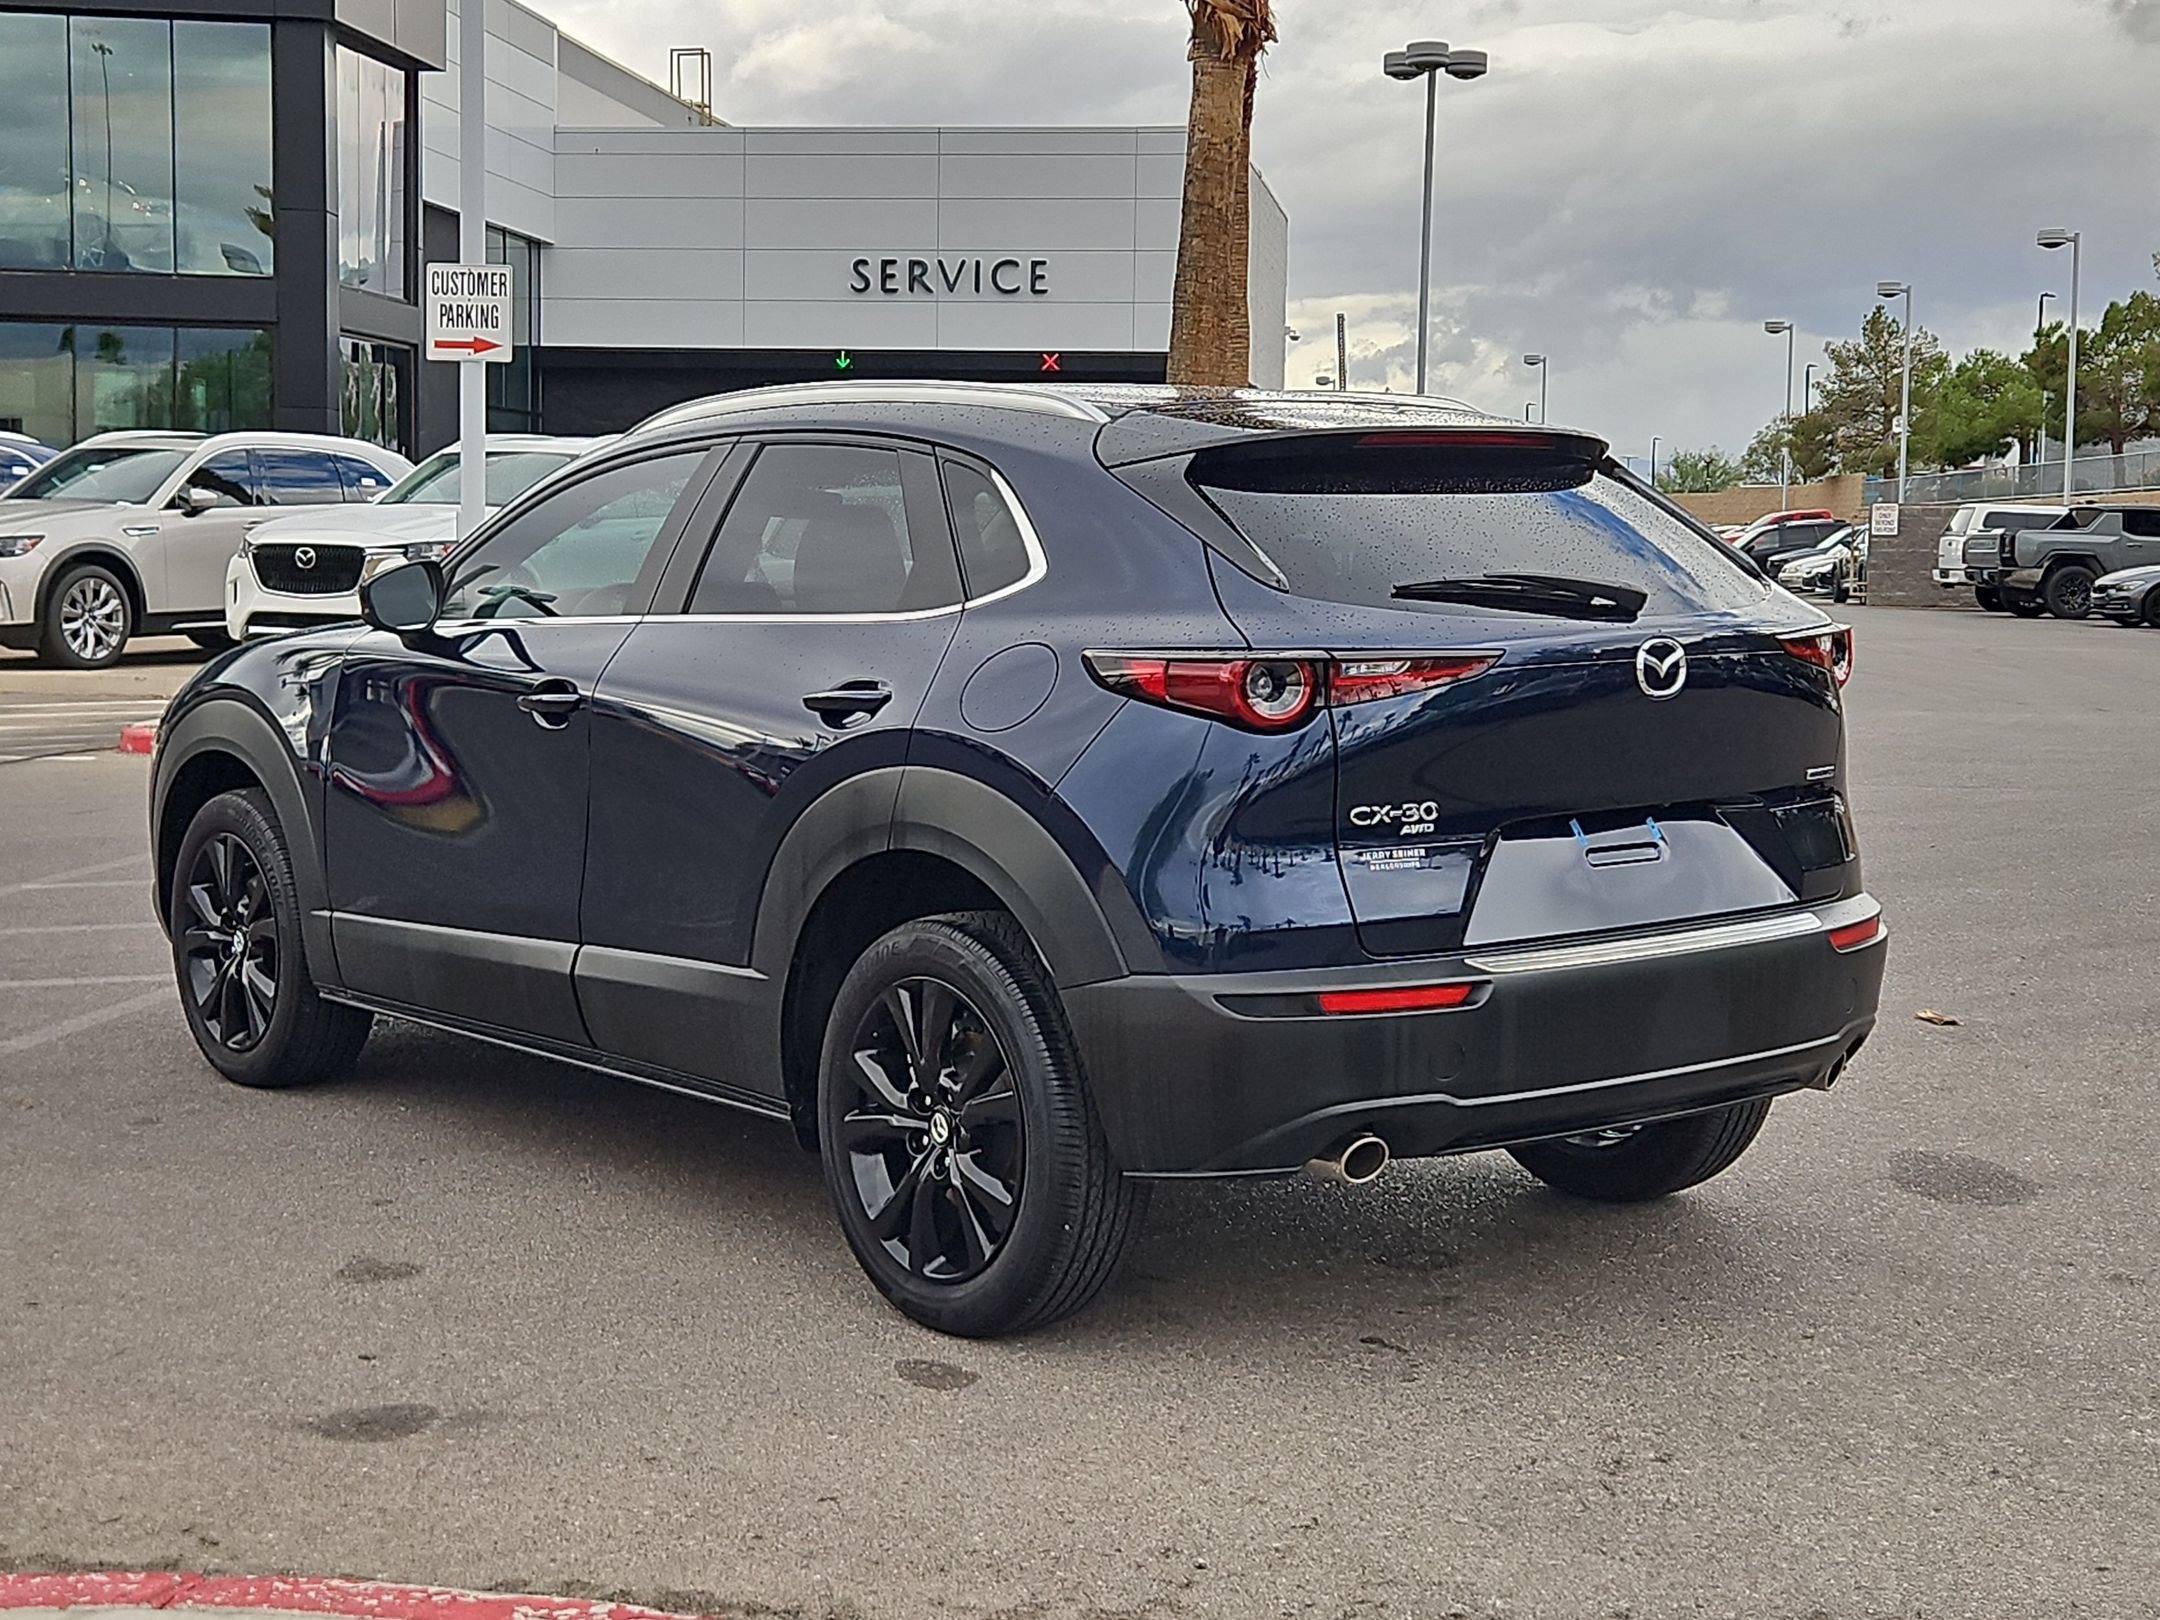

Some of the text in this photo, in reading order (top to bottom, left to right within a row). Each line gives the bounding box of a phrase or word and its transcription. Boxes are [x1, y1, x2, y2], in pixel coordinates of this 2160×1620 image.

[431, 270, 508, 297] CUSTOMER
[849, 258, 1048, 294] SERVICE
[439, 303, 499, 329] PARKING
[1350, 801, 1439, 825] CX-30
[1400, 823, 1434, 835] AWD
